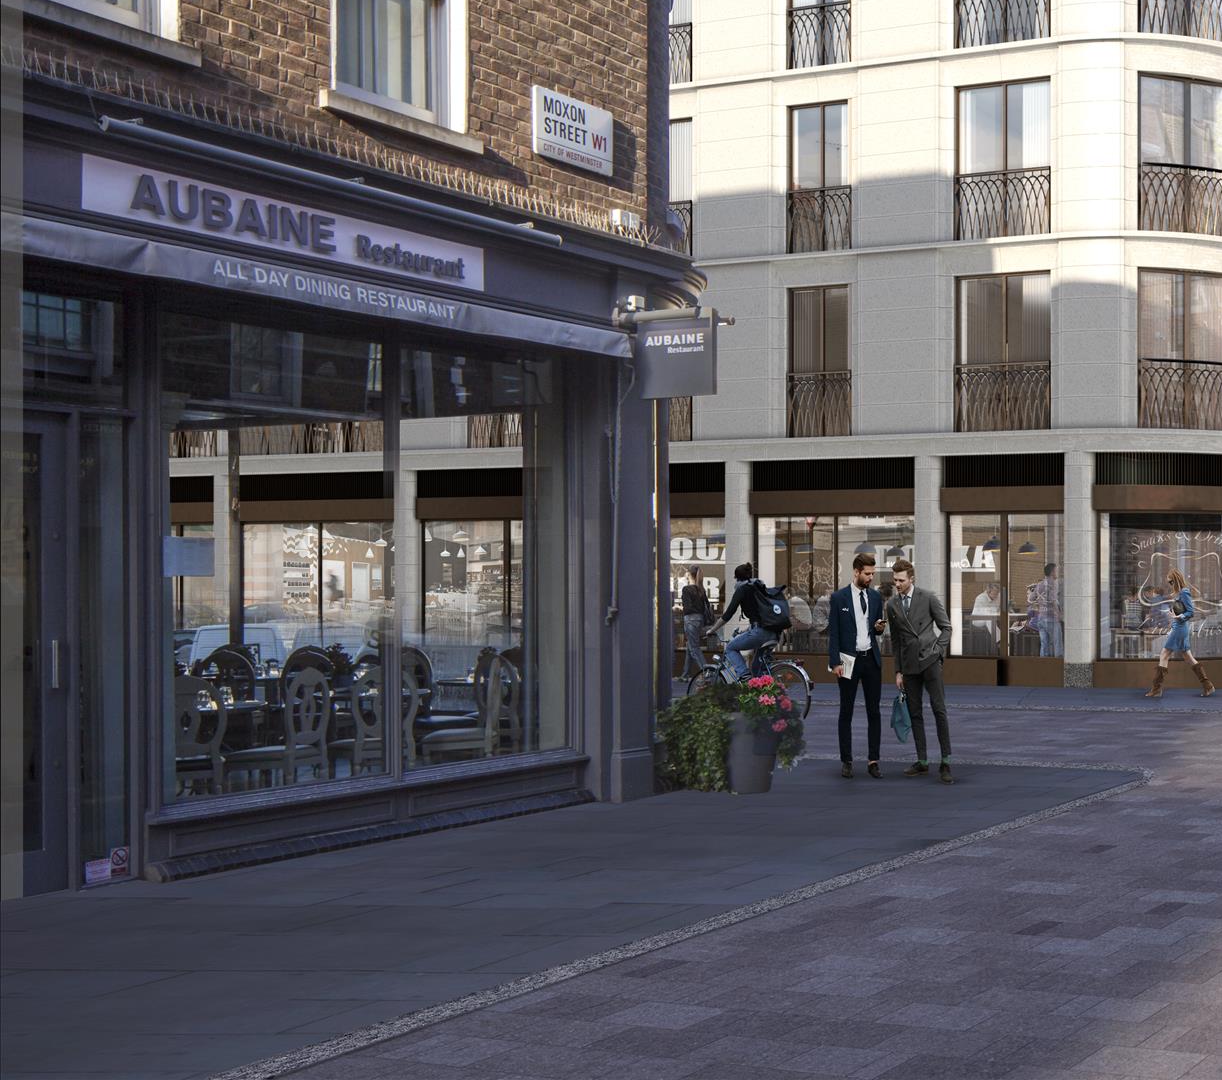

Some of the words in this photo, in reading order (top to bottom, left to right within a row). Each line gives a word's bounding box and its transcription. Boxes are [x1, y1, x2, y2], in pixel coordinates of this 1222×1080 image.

[543, 95, 586, 126] MOXON
[544, 117, 588, 146] STREET
[591, 132, 607, 153] W1
[543, 143, 557, 155] CITY
[557, 147, 565, 157] OF
[565, 150, 603, 169] WESTMINSTER
[130, 173, 337, 253] AUBAINE
[356, 233, 465, 280] Restaurant
[213, 259, 249, 281] ALL
[255, 268, 290, 289] DAY
[295, 276, 351, 301] DINING
[357, 288, 456, 320] RESTAURANT
[645, 332, 705, 347] AUBAINE
[667, 345, 704, 354] Restaurant
